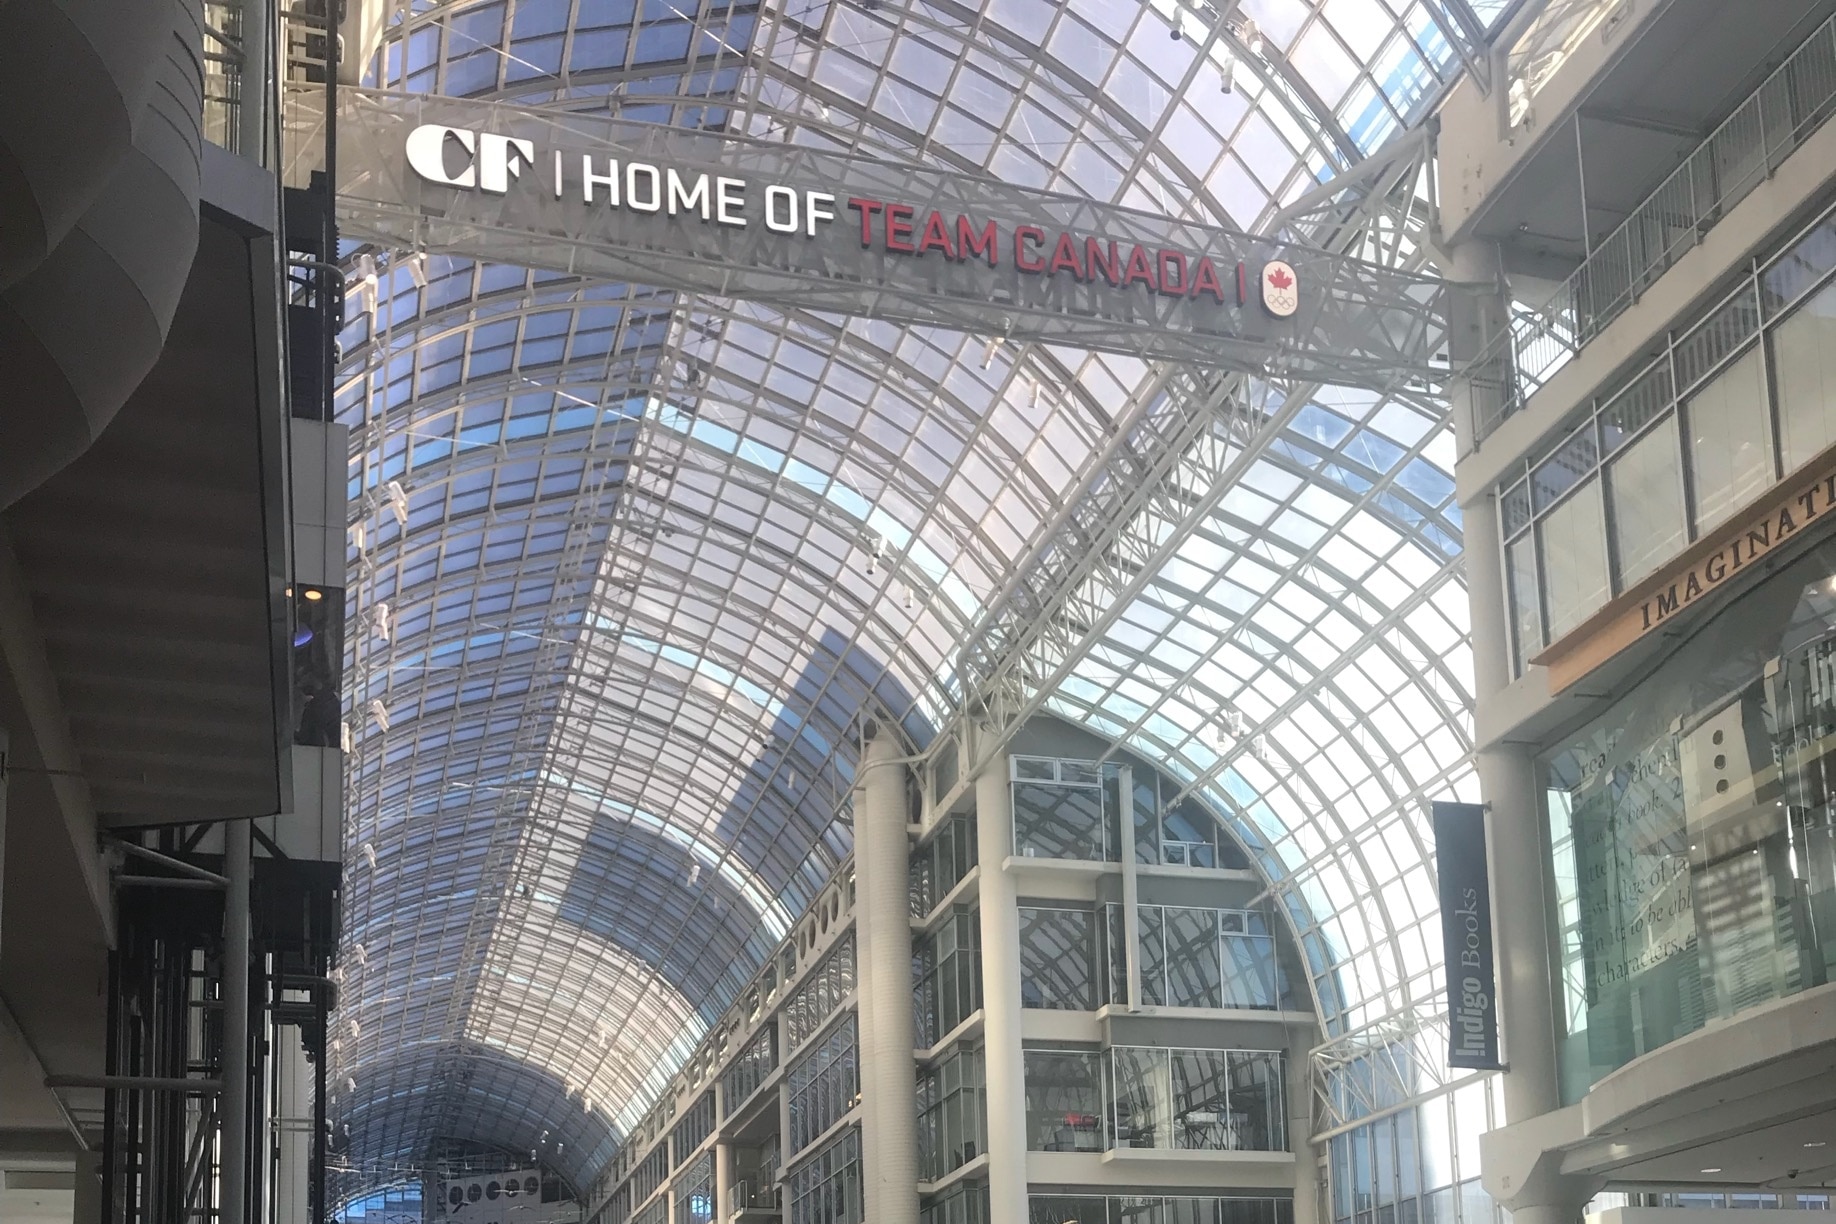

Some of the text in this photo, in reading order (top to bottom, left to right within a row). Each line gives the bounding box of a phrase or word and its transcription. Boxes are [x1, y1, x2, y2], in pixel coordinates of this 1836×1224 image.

[405, 123, 1227, 305] CF HOME OF TEAM CANADA
[1639, 472, 1836, 631] IMAGINATI
[1454, 887, 1481, 969] Books
